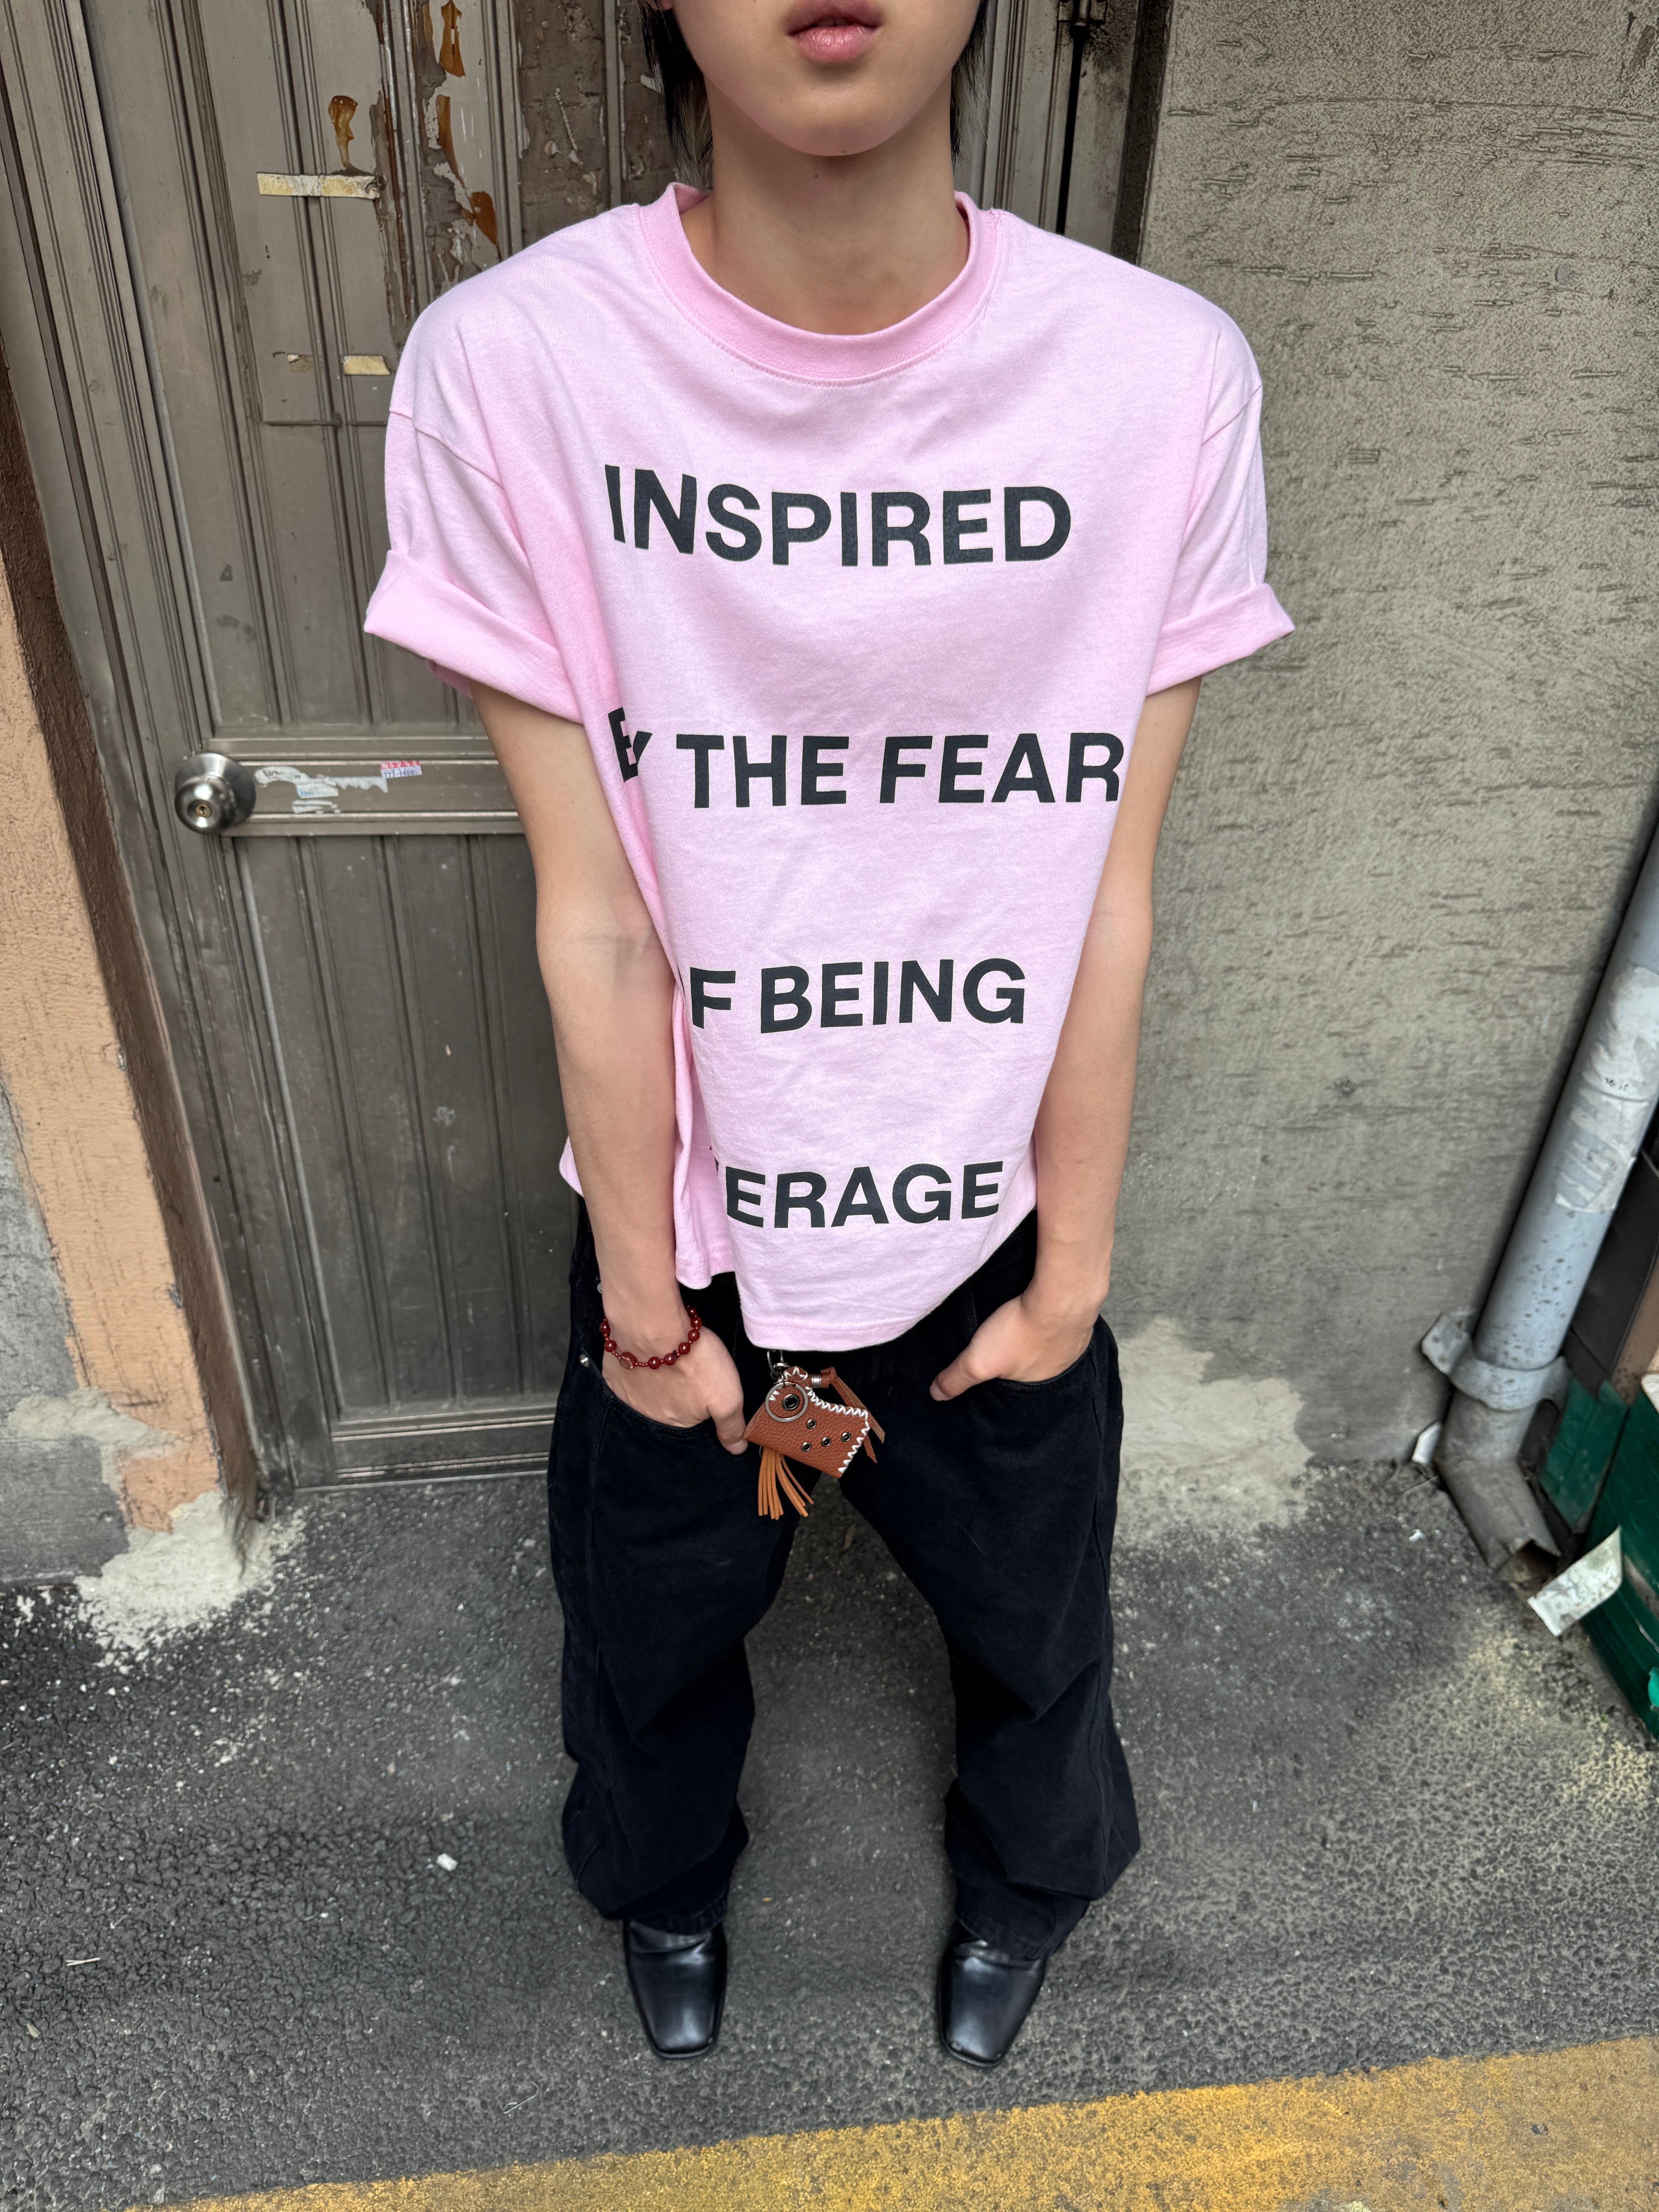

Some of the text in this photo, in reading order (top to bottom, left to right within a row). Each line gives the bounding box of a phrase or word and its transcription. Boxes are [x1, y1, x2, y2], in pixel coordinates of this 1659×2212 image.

[605, 464, 1071, 566] INSPIRED
[676, 733, 850, 808] THE
[880, 732, 1124, 804] FEAR
[677, 958, 1026, 1034] F BEING
[714, 1156, 1004, 1229] ERAGE
